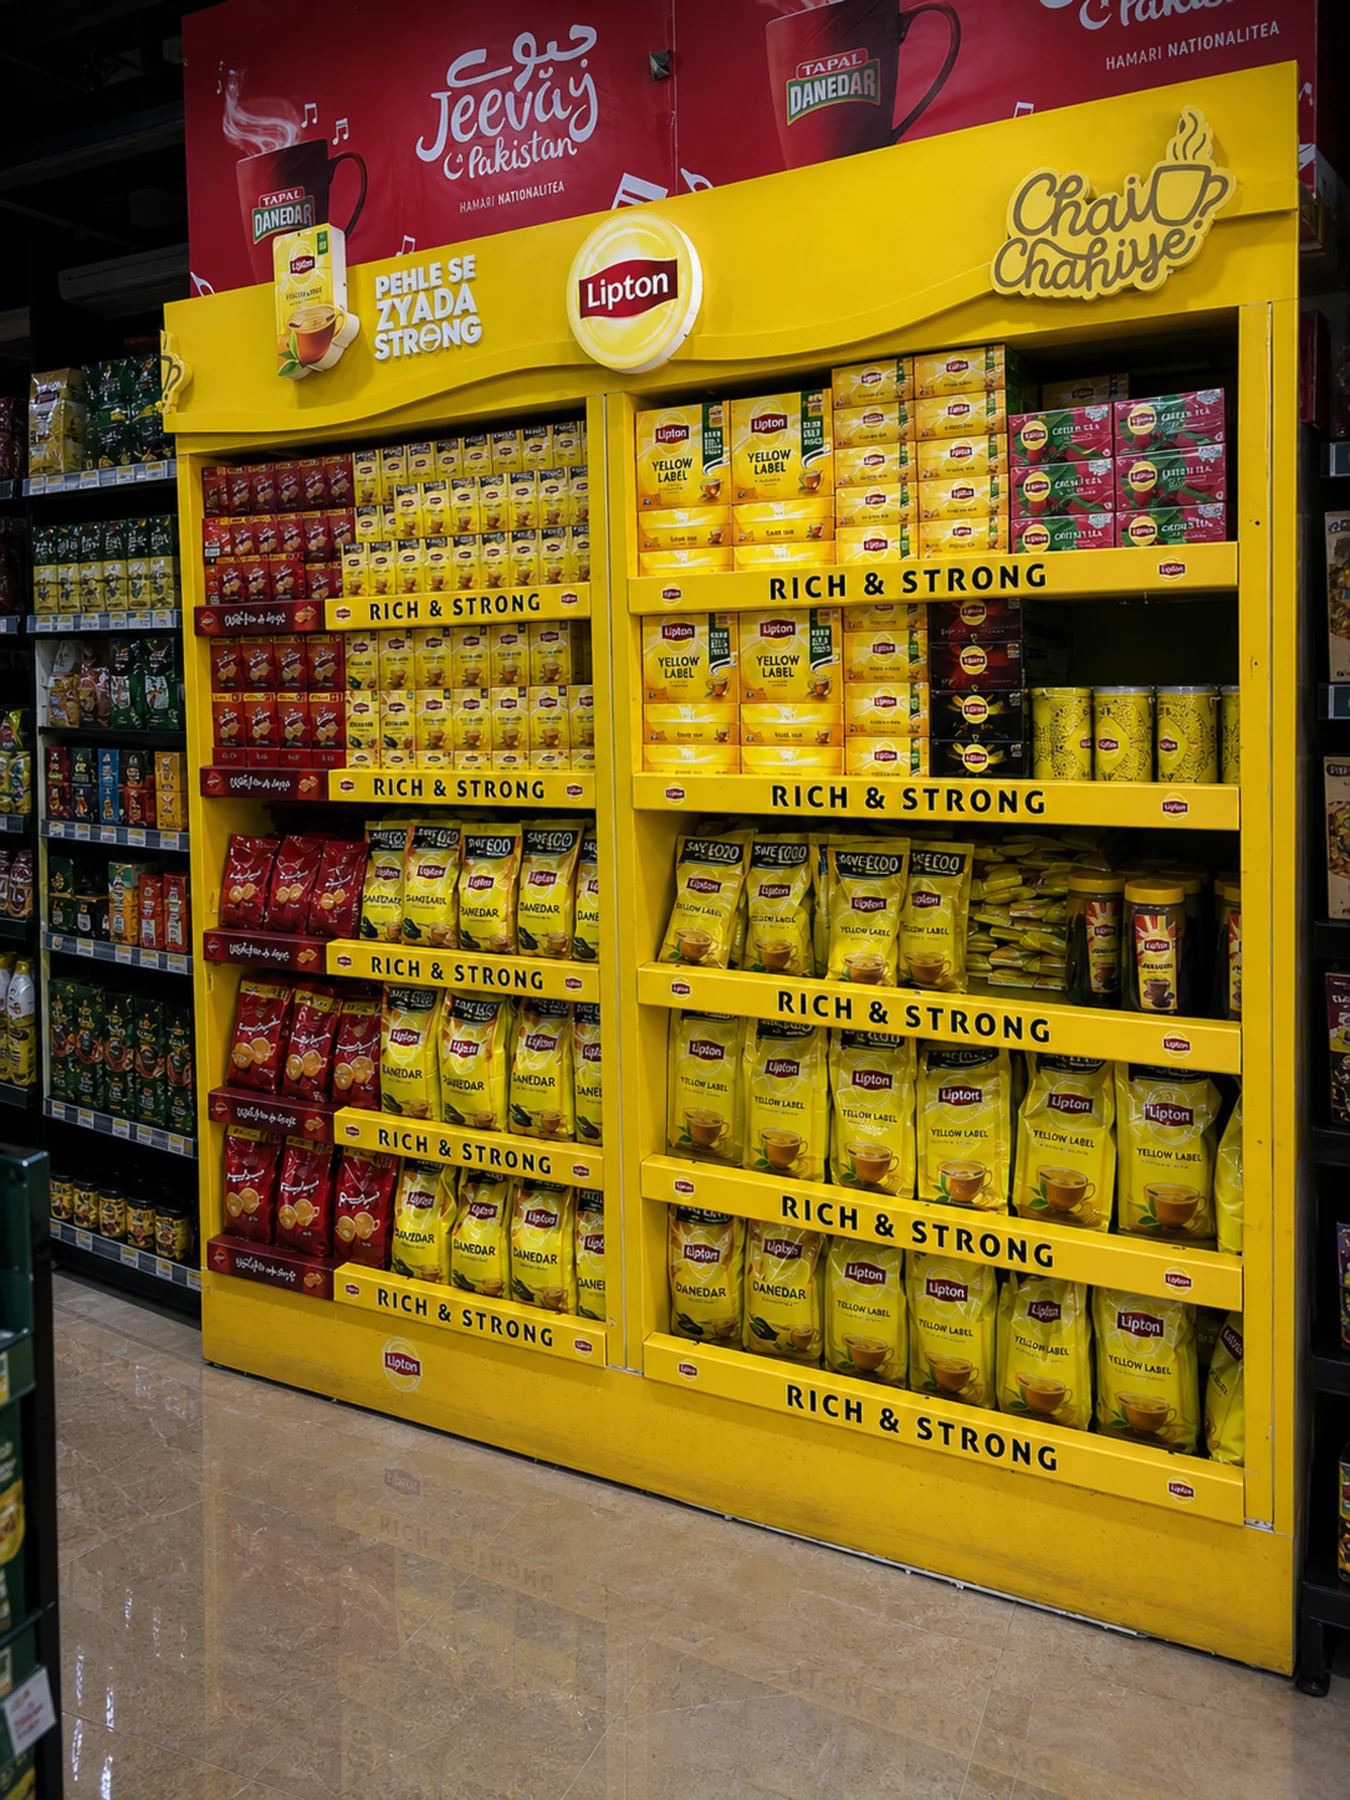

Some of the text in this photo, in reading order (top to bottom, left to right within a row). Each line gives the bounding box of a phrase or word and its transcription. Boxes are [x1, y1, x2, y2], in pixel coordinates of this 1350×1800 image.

[1106, 20, 1280, 70] HAMARI NATIONALITEA
[802, 53, 862, 76] TAPAL
[790, 69, 875, 116] DANEDAR
[416, 72, 598, 162] Jeevay
[468, 130, 578, 178] Pakistan
[262, 190, 300, 206] TAPAL
[460, 180, 565, 213] HAMARI NATIONALITEA
[1013, 173, 1148, 236] Chai
[254, 204, 312, 238] DANEDAR
[376, 254, 476, 300] PEHLE SE
[586, 272, 669, 310] Lipton
[376, 283, 478, 332] ZYADA
[374, 316, 482, 360] STRONG
[754, 418, 784, 432] Lipton
[658, 428, 688, 442] Lipton
[652, 458, 693, 472] YELLOW
[748, 449, 791, 464] YELLOW
[658, 470, 688, 483] LABEL
[754, 462, 786, 475] LABEL
[770, 562, 1046, 600] RICH & STRONG
[370, 593, 540, 620] RICH & STRONG
[664, 626, 692, 638] Lipton
[763, 623, 793, 636] Lipton
[658, 656, 700, 667] YELLOW
[756, 656, 800, 666] YELLOW
[664, 667, 694, 679] LABEL
[762, 666, 794, 678] LABEL
[373, 777, 545, 799] RICH & STRONG
[772, 785, 1045, 815] RICH & STRONG
[854, 899, 884, 910] Lipton
[372, 955, 544, 990] RICH & STRONG
[778, 990, 1050, 1043] RICH & STRONG
[692, 1042, 722, 1058] Lipton
[768, 1061, 798, 1076] Lipton
[680, 1076, 728, 1092] YELLOW LABEL
[856, 1072, 890, 1088] Lipton
[755, 1096, 805, 1110] YELLOW LABEL
[942, 1089, 980, 1103] Lipton
[1052, 1095, 1090, 1112] Lipton
[842, 1109, 898, 1123] YELLOW LABEL
[1150, 1107, 1190, 1124] Lipton
[932, 1128, 988, 1139] YELLOW LABEL
[1034, 1129, 1095, 1148] YELLOW LABEL
[378, 1128, 552, 1174] RICH & STRONG
[1136, 1147, 1202, 1162] YELLOW LABEL
[782, 1196, 1054, 1268] RICH & STRONG
[454, 1238, 496, 1256] DANEDAR
[686, 1247, 718, 1261] Lipton
[513, 1248, 558, 1265] DANEDAR
[848, 1264, 883, 1281] Lipton
[676, 1280, 726, 1298] DANEDAR
[753, 1280, 806, 1300] DANEDAR
[930, 1282, 965, 1300] Lipton
[378, 1288, 554, 1348] RICH & STRONG
[838, 1300, 890, 1318] YELLOW LABEL
[1032, 1302, 1058, 1319] Lipton
[918, 1318, 974, 1337] YELLOW LABEL
[1122, 1316, 1160, 1334] Lipton
[388, 1356, 420, 1377] Lipton
[1108, 1354, 1172, 1375] YELLOW LABEL
[787, 1384, 1058, 1472] RICH & STRONG
